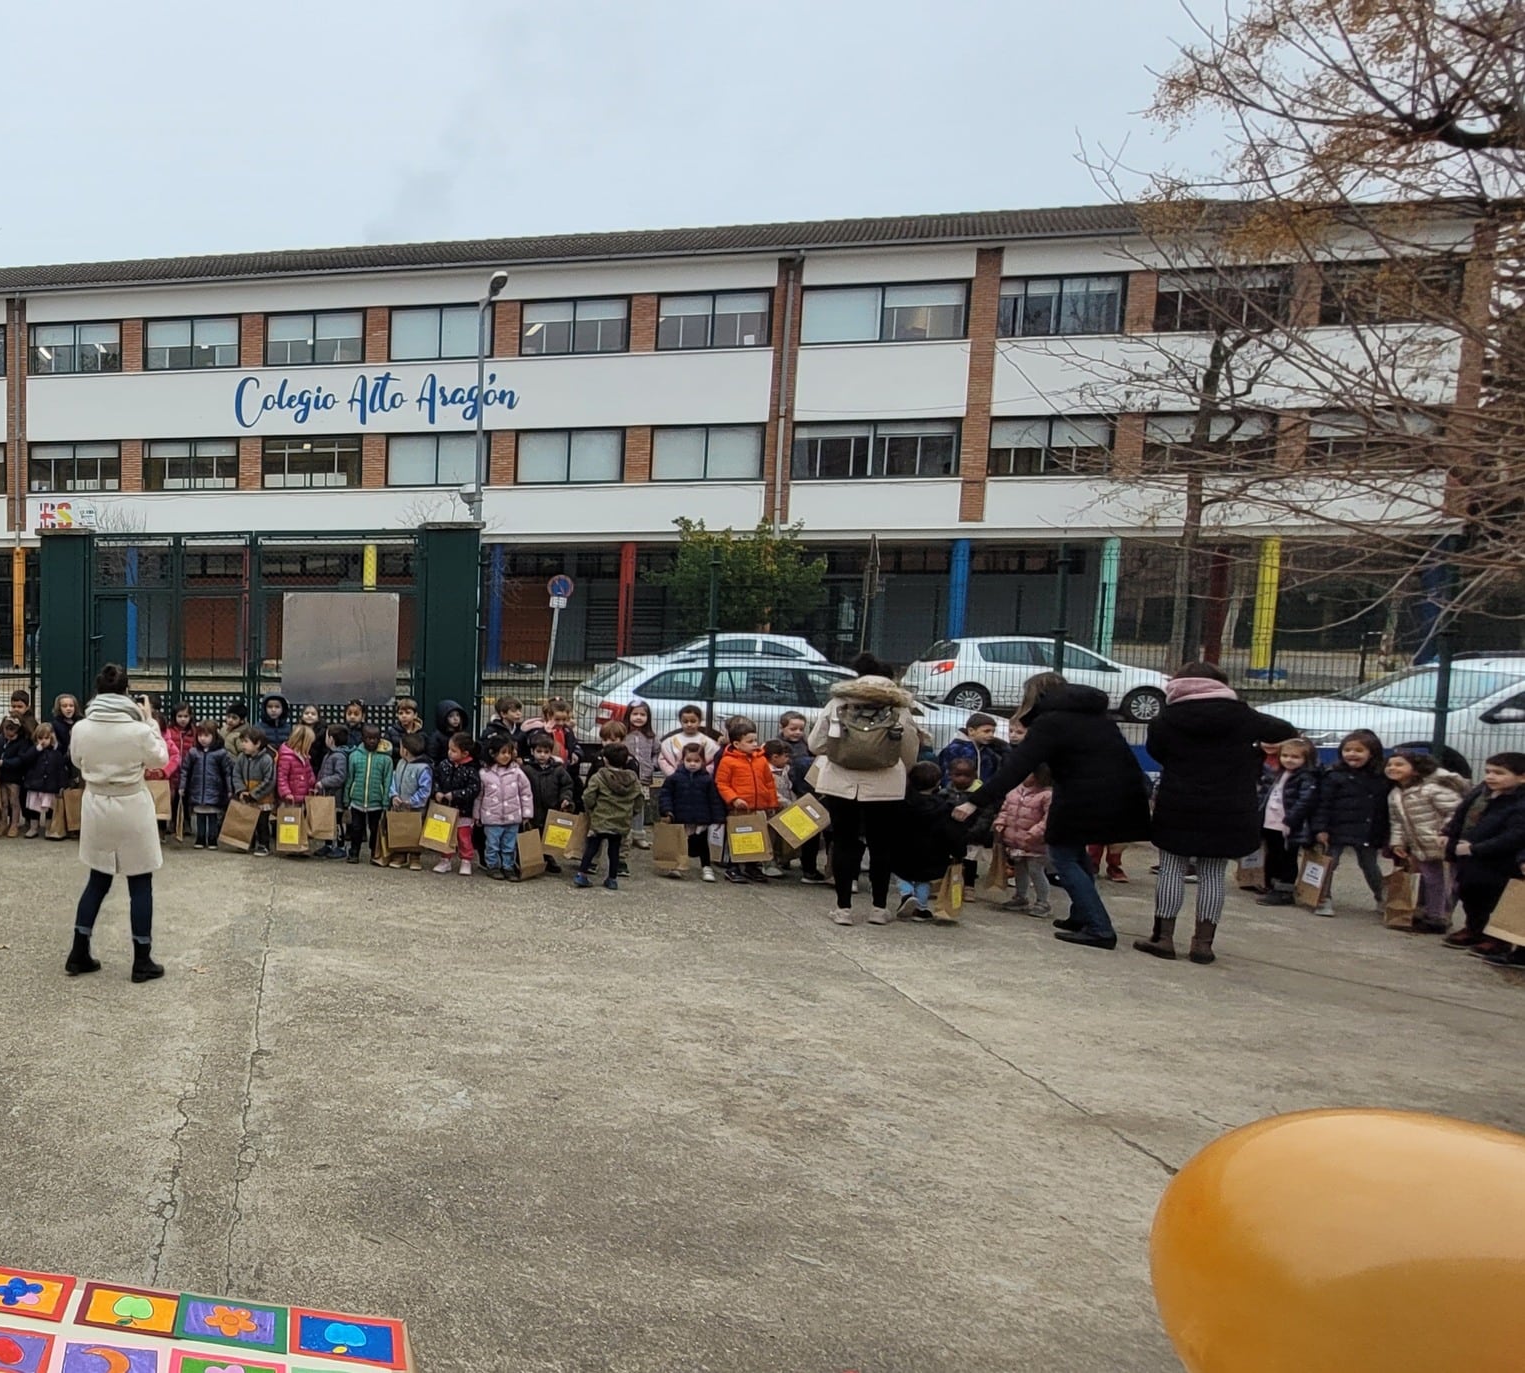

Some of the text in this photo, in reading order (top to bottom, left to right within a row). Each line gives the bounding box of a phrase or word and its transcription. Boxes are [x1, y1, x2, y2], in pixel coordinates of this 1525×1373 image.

[235, 371, 520, 428] Colegio Alto Aragón
